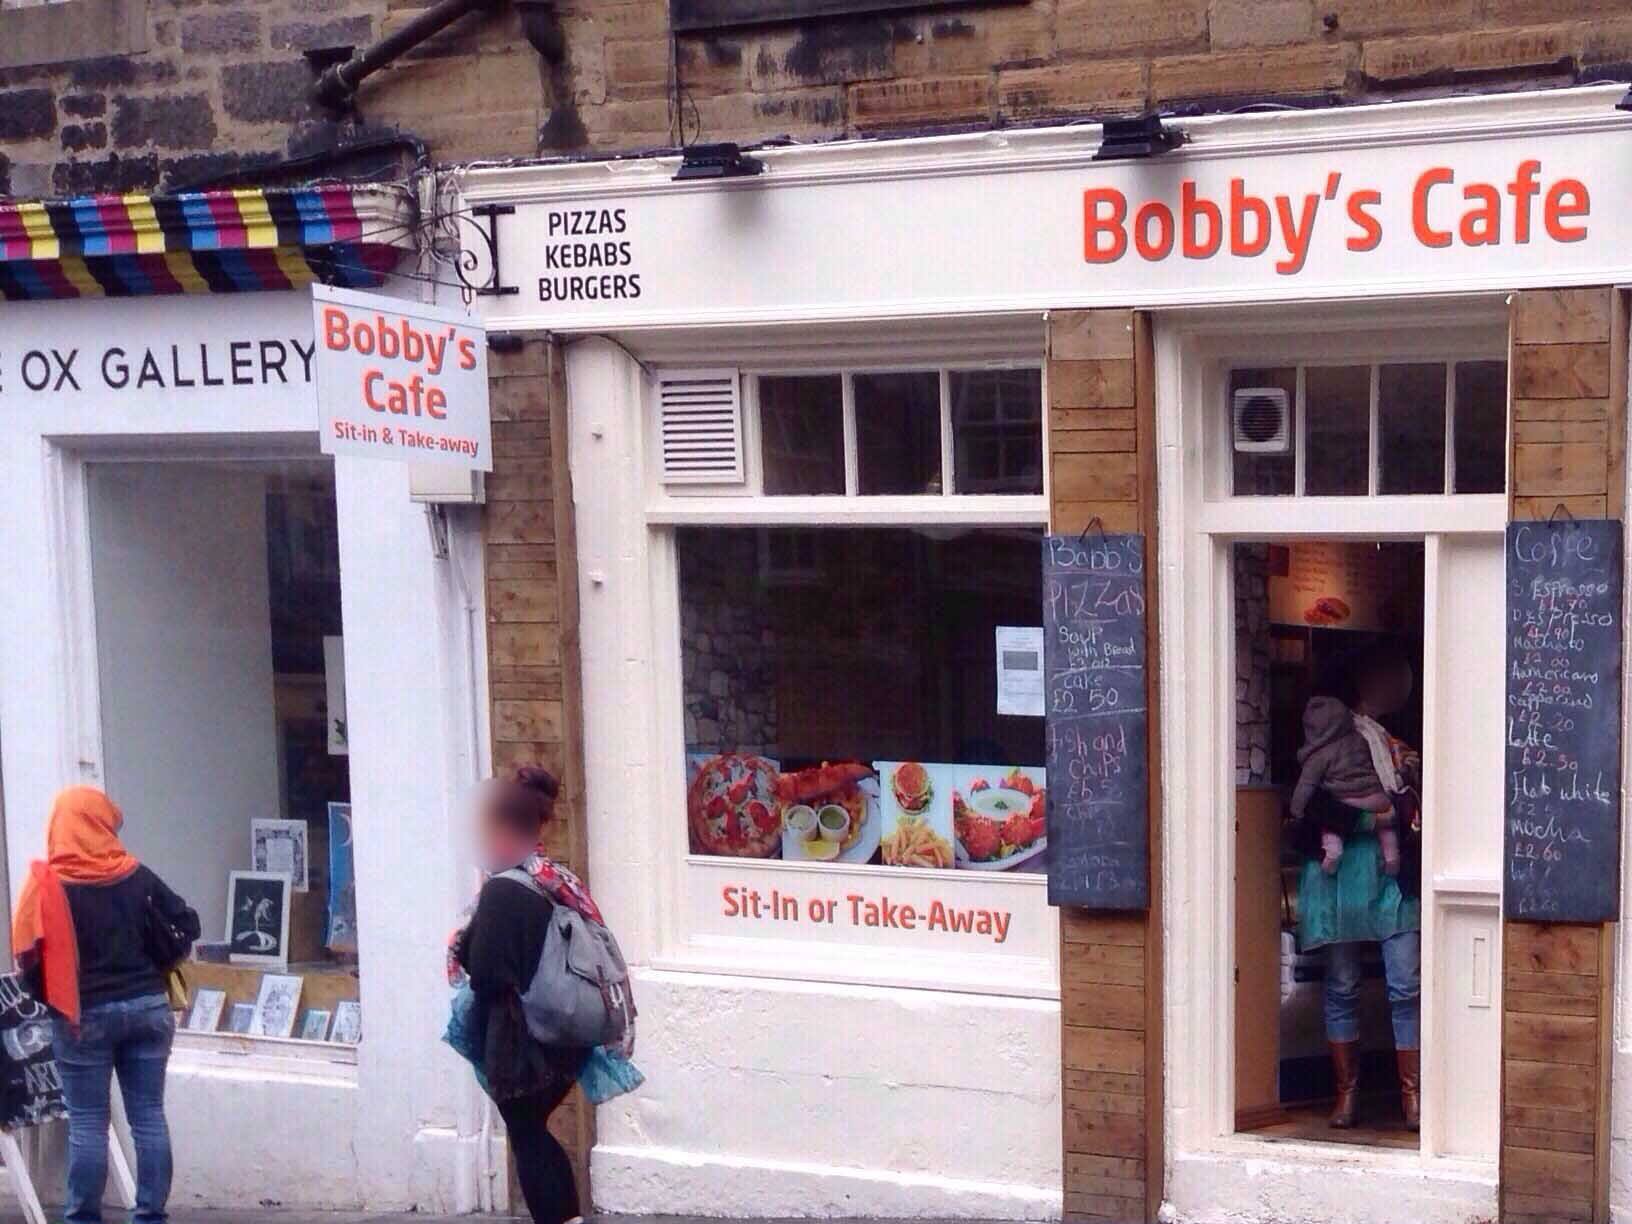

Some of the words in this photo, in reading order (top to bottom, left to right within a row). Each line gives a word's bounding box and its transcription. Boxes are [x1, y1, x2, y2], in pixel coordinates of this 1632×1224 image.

[548, 208, 627, 237] PIZZAS
[1083, 172, 1383, 275] Bobby's
[1412, 160, 1590, 249] Cafe
[545, 241, 632, 269] KEBABS
[538, 273, 642, 302] BURGERS
[21, 348, 81, 391] OX
[101, 338, 316, 390] GALLERY
[323, 307, 477, 376] Bobby's
[363, 370, 448, 420] Cafe
[334, 421, 377, 443] Sit-in
[382, 427, 394, 446] &
[400, 429, 479, 458] Take-away
[722, 886, 799, 921] Sit-In
[808, 898, 837, 924] or
[847, 894, 1012, 943] Take-Away
